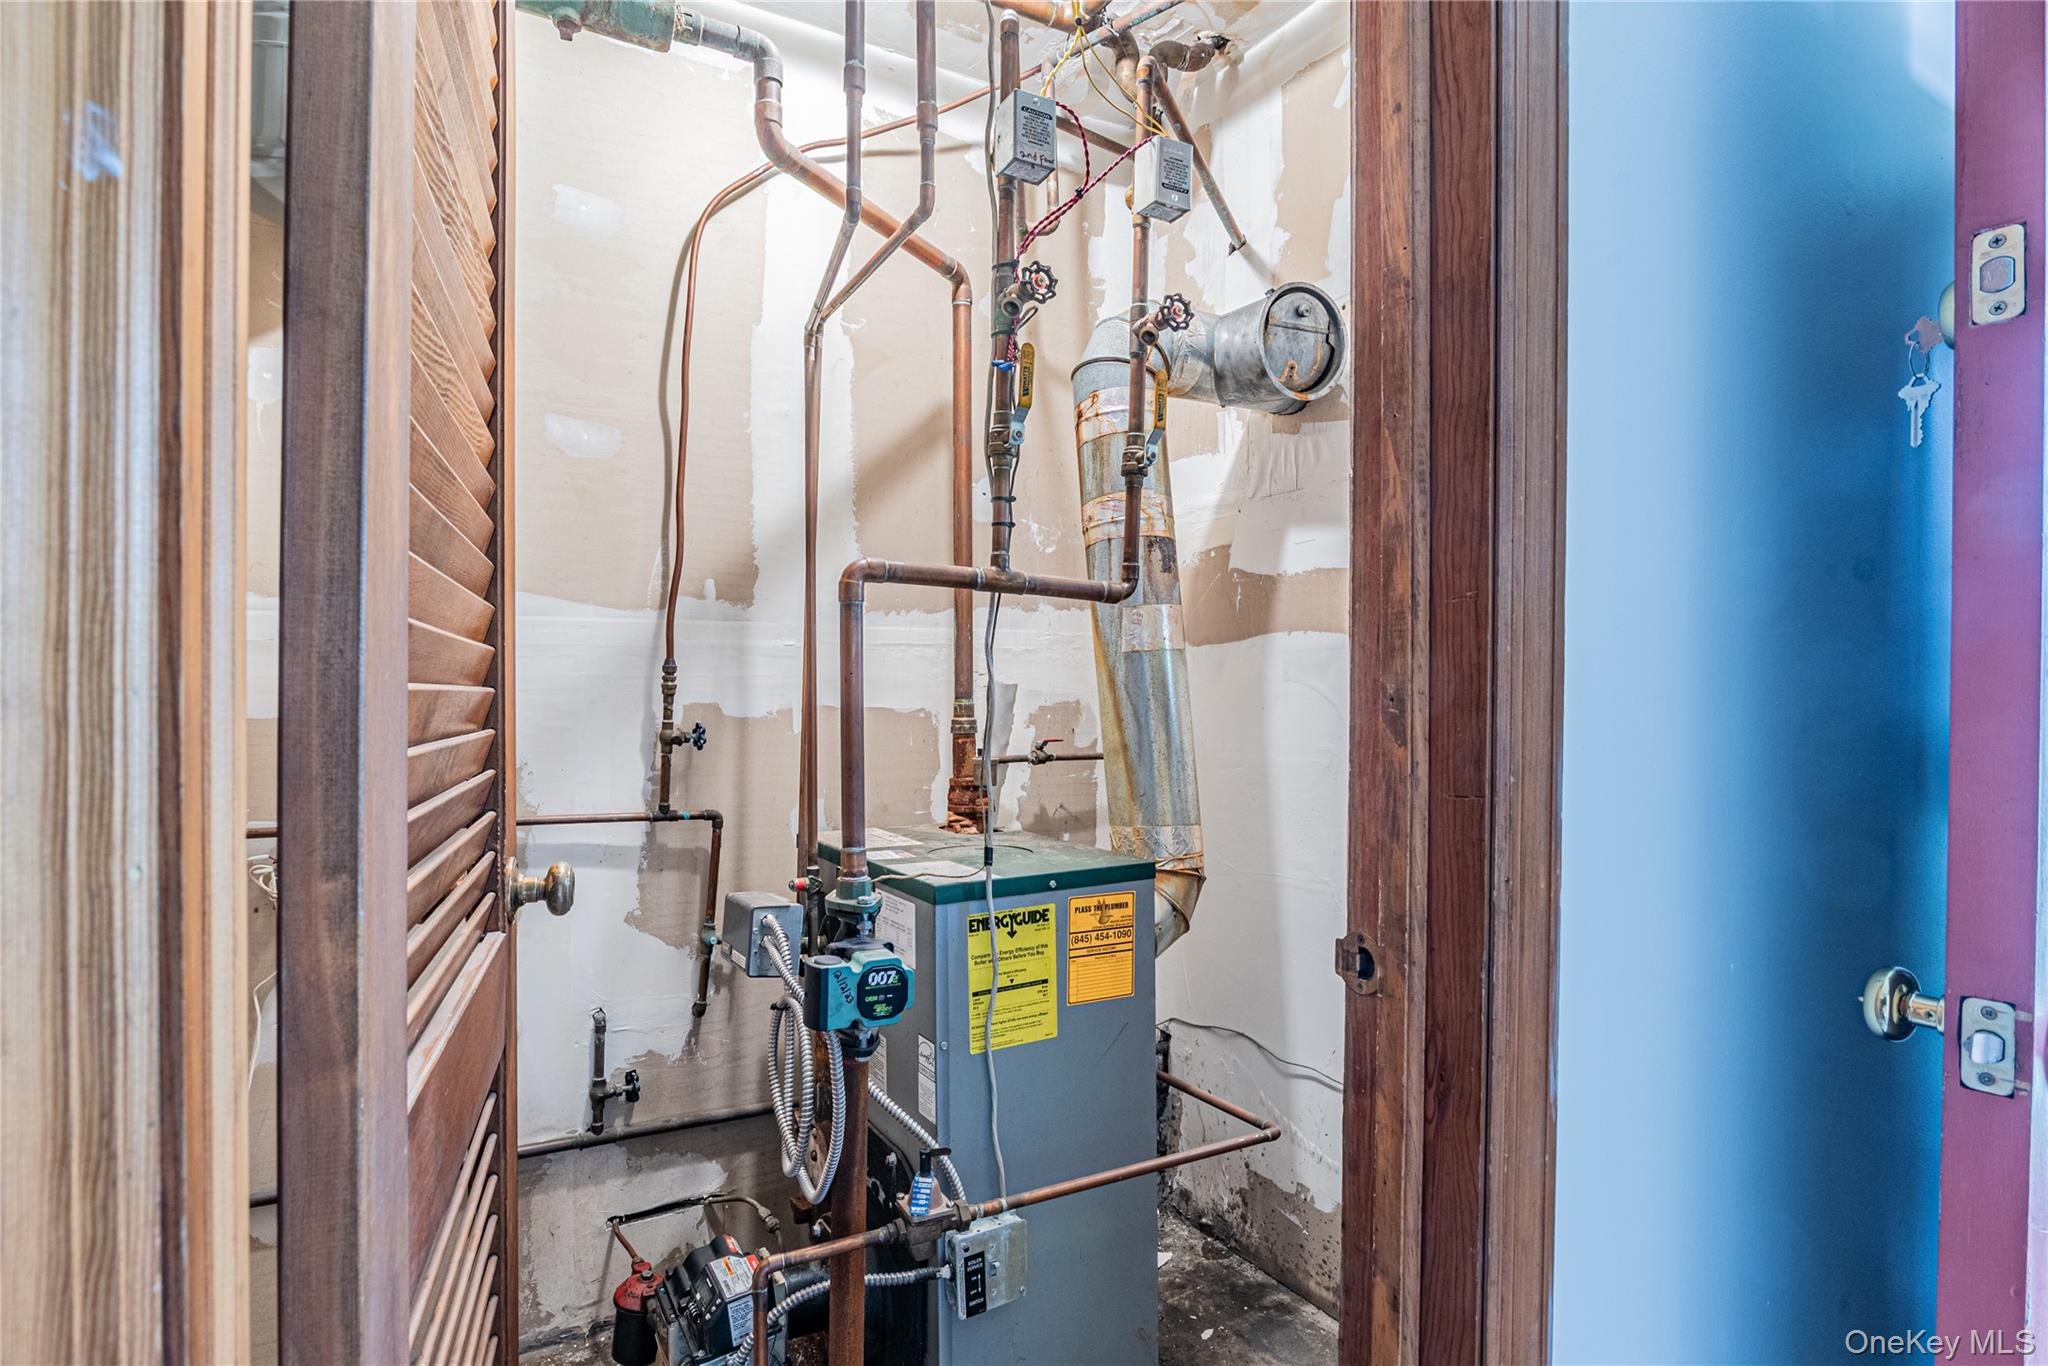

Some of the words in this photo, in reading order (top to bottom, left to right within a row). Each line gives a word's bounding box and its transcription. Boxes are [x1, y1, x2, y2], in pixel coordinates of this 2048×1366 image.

[1074, 905, 1092, 914] PLASS
[1105, 902, 1129, 911] PLUMBER
[1071, 934, 1093, 946] (845)
[1094, 929, 1132, 941] 454-1090
